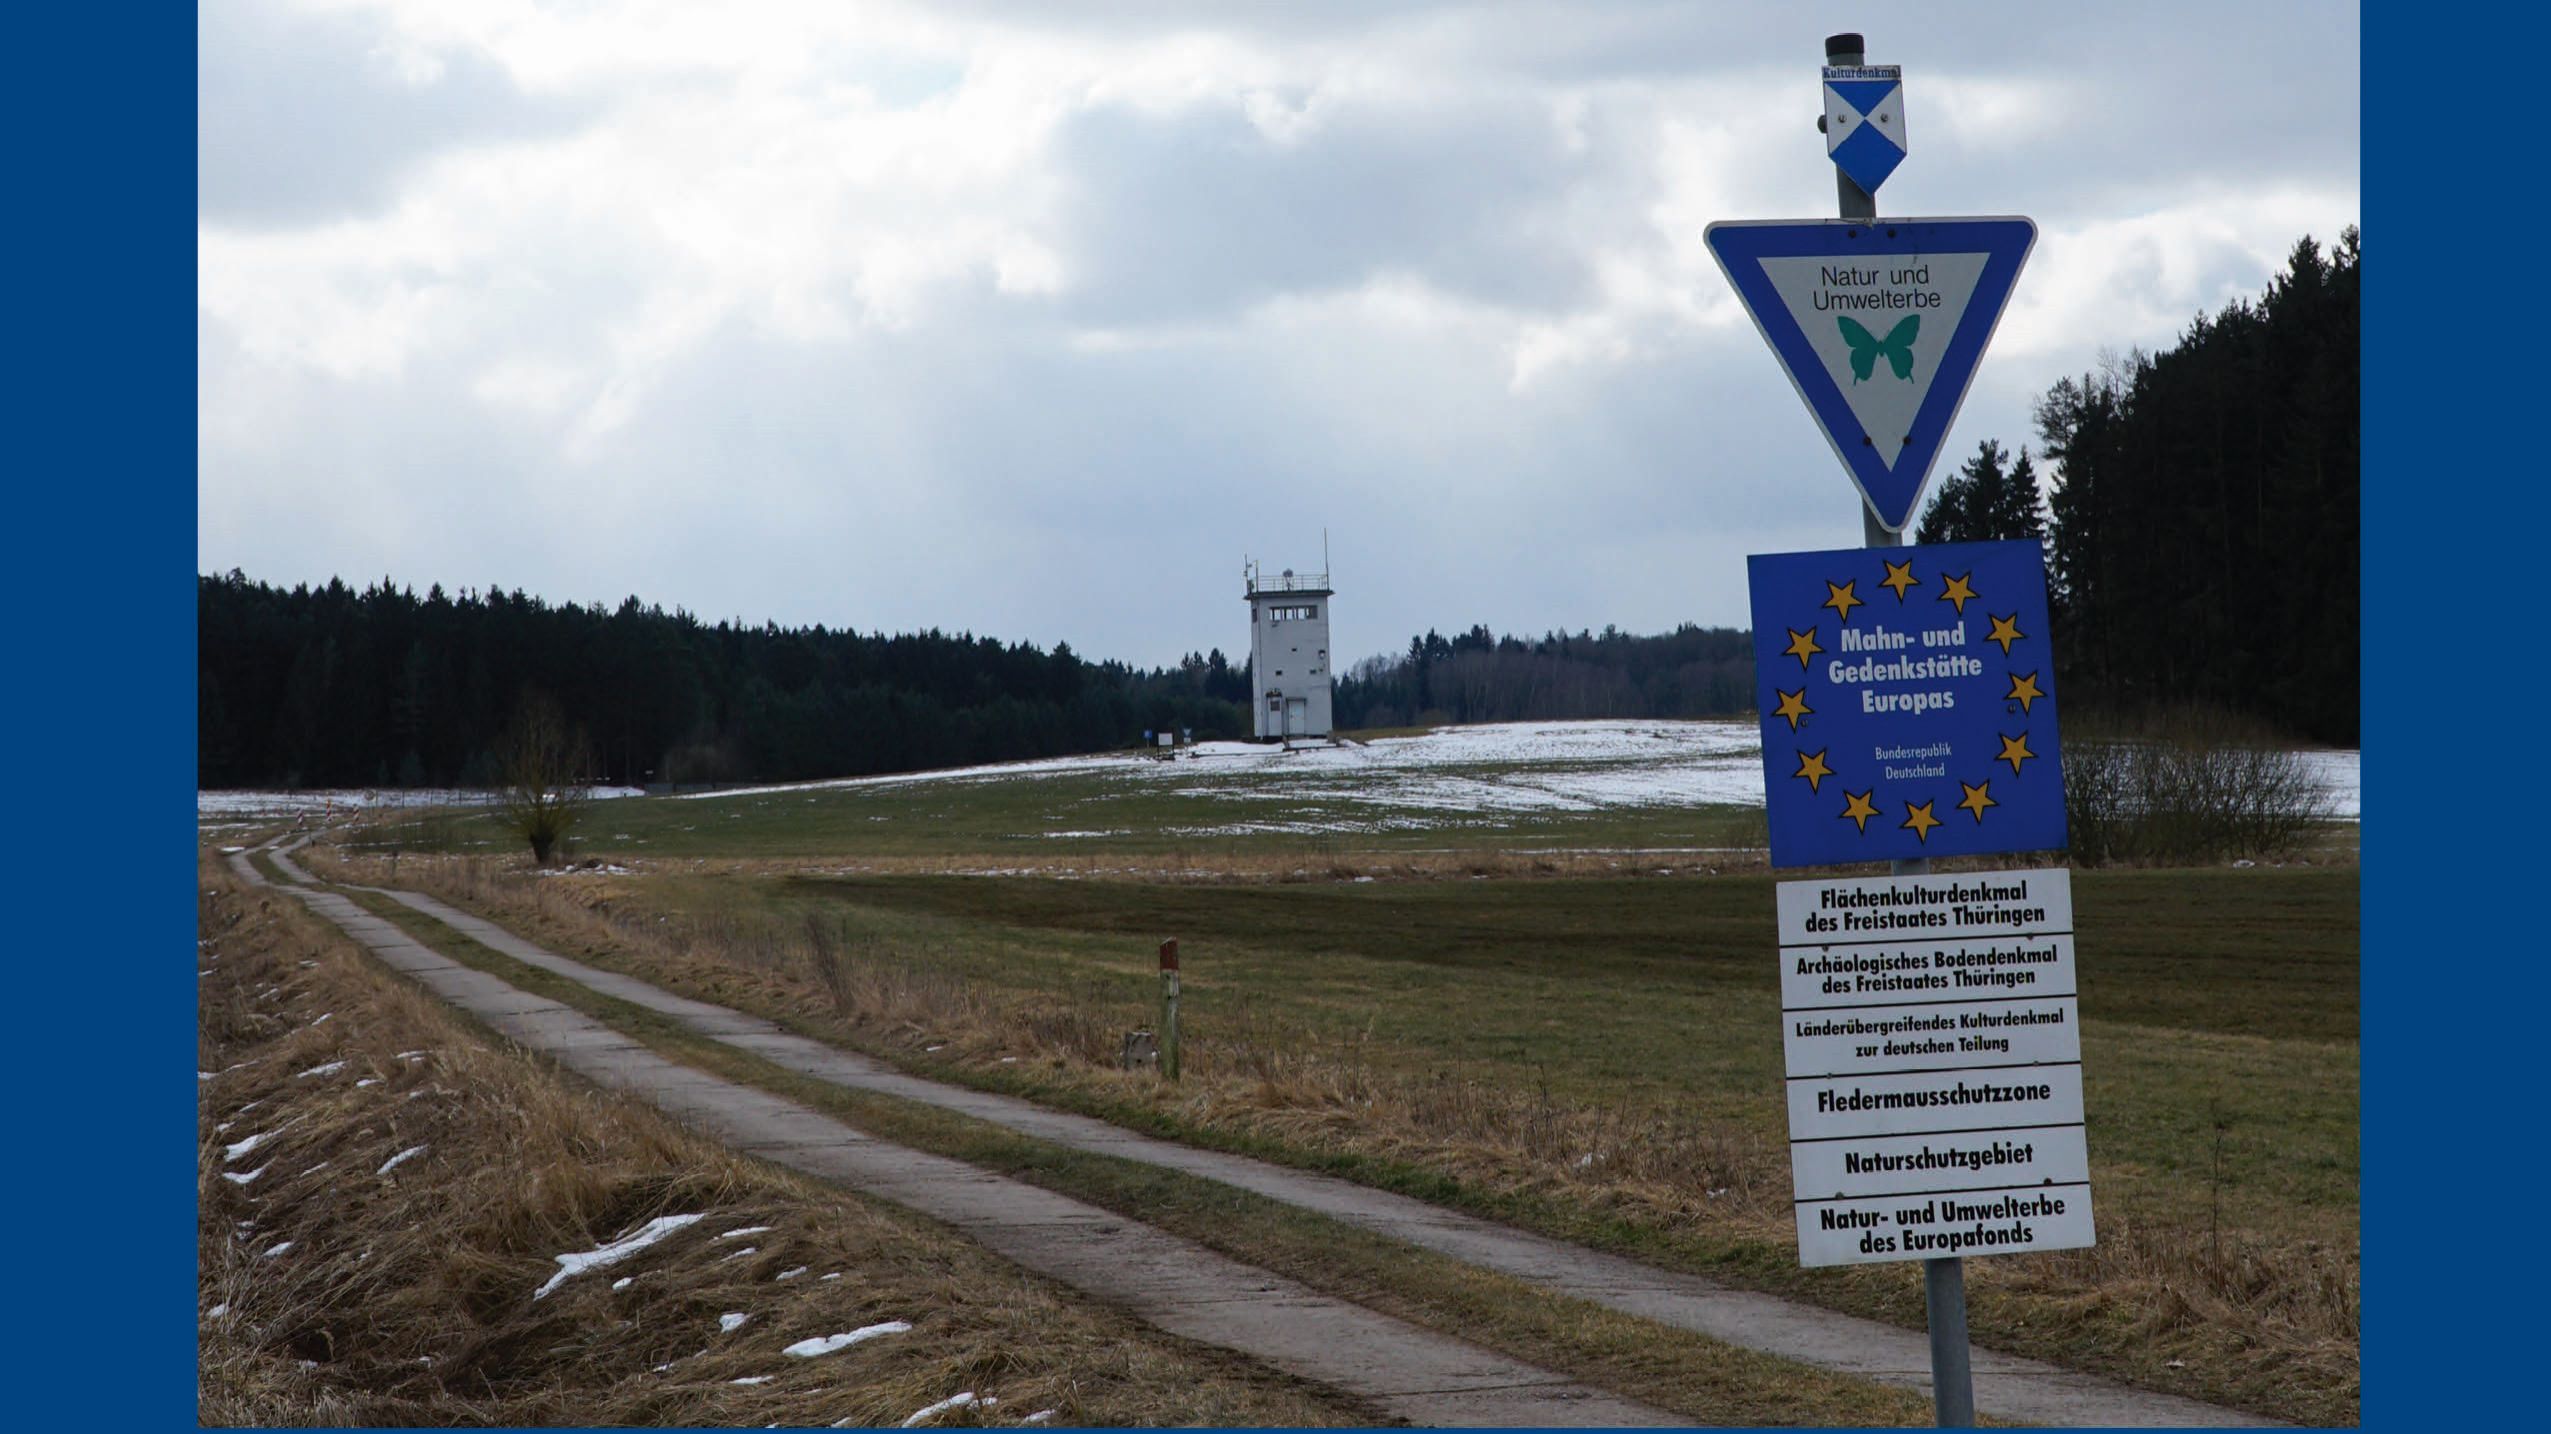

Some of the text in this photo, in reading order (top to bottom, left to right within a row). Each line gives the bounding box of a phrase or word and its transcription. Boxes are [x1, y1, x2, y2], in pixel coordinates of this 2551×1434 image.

[1823, 67, 1901, 79] Kulturdenkmal
[1821, 265, 1929, 287] Natur und
[1814, 289, 1941, 311] Umwelterbe
[1841, 621, 1966, 652] Mahn- und
[1829, 654, 1982, 683] Gedenkstätte
[1862, 690, 1954, 715] Europas
[1875, 742, 1952, 762] Bundesrepublik
[1885, 763, 1945, 780] Deutschland
[1821, 880, 2027, 909] Flächenkulturdenkmal
[1805, 904, 2045, 933] des Freistaates Thüringen
[1797, 944, 2058, 975] Archäologisches Bodendenkmal
[1822, 966, 2036, 994] des Freistaates Thüringen
[1796, 1008, 2064, 1038] Länderübergreifendes Kulturdenkmal
[1856, 1035, 2009, 1057] zur deutschen Teilung
[1818, 1082, 2051, 1113] Fledermausschutzzone
[1845, 1142, 2033, 1174] Naturschutzgebiet
[1820, 1194, 2065, 1231] Natur- und Umwelterbe
[1860, 1221, 2033, 1255] des Europafonds
